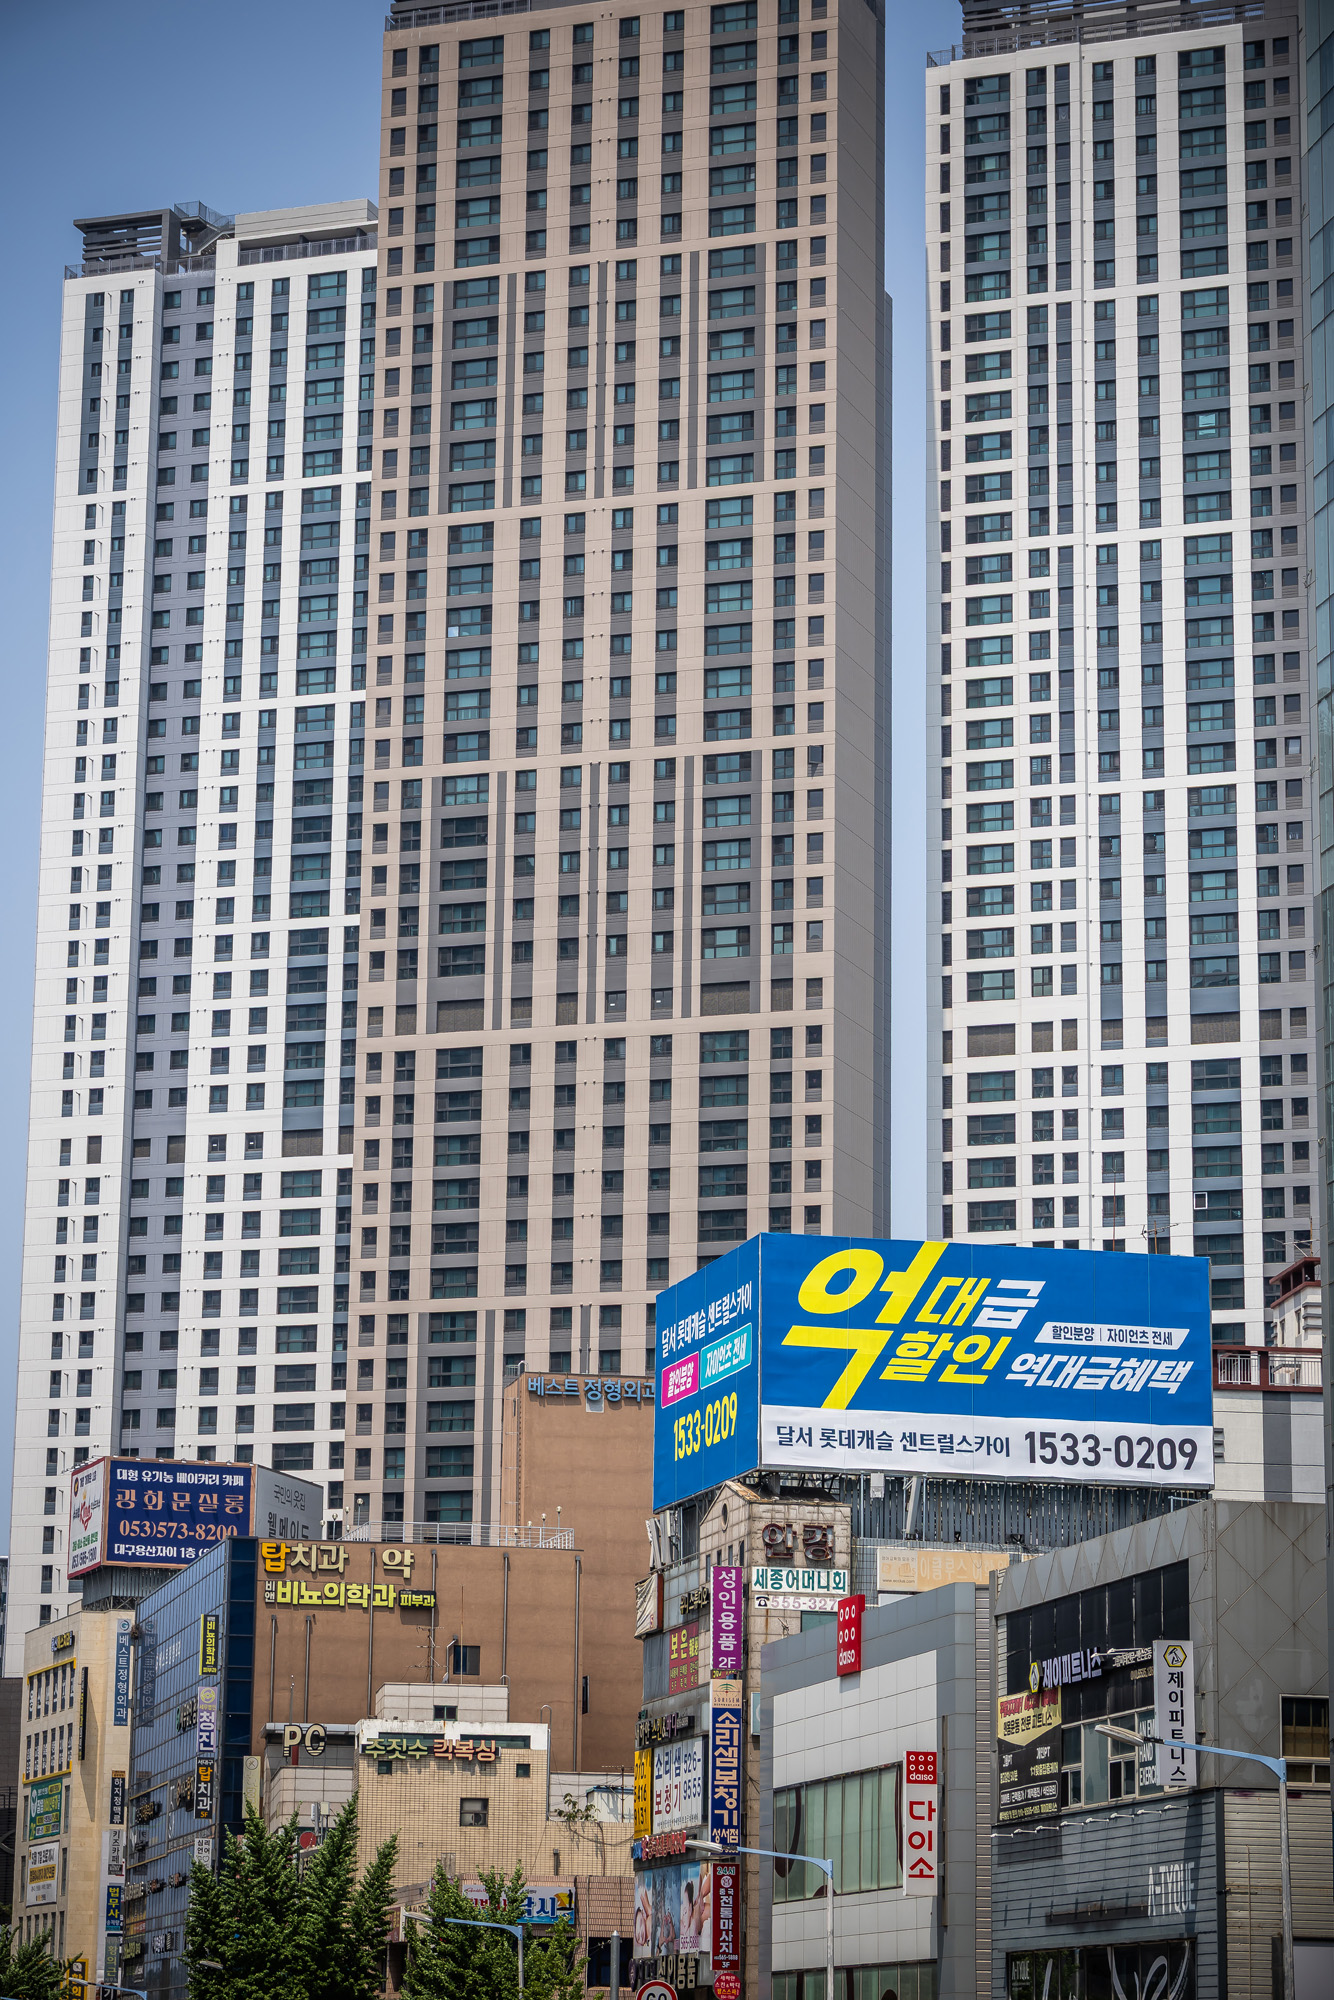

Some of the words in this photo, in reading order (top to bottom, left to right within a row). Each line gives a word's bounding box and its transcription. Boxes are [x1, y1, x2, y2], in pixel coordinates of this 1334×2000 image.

[661, 1322, 676, 1359] 달서
[677, 1308, 706, 1350] 롯데캐슬
[707, 1281, 752, 1334] 센트럴스카이
[1051, 1324, 1095, 1342] 할인분양
[1106, 1327, 1150, 1344] 자이언츠
[1151, 1329, 1174, 1346] 전세
[667, 1361, 695, 1398] 할인분양
[705, 1342, 732, 1379] 자이언츠
[732, 1333, 748, 1366] 전세
[1005, 1353, 1194, 1395] 역대급혜택
[673, 1391, 738, 1462] 1533-0209
[776, 1425, 814, 1448] 달서
[818, 1427, 895, 1452] 롯데캐슬
[899, 1431, 1010, 1458] 센트럴스카이
[1024, 1430, 1198, 1471] 1533-0209
[116, 1468, 139, 1482] 대형
[141, 1469, 174, 1483] 유기농
[176, 1472, 220, 1486] 베이커리
[222, 1474, 244, 1487] 카페
[119, 1519, 238, 1541] 053)573-8200
[762, 1522, 835, 1561] 안경
[114, 1543, 177, 1558] 대구용산자이
[179, 1546, 196, 1559] 1층
[261, 1542, 349, 1573] 탑치과
[382, 1549, 414, 1579] 약
[277, 1581, 397, 1608] 비뇨의학과
[400, 1594, 436, 1608] 피부과
[753, 1568, 847, 1593] 세종어머니회
[718, 1569, 738, 1651] 성인용품
[771, 1596, 837, 1611] 555-327
[718, 1657, 737, 1669] 2F
[839, 1648, 856, 1666] daiso
[1042, 1647, 1102, 1688] 제이피트니스
[116, 1635, 130, 1720] 베스트정형외과
[198, 1711, 215, 1753] 청진
[283, 1723, 327, 1757] PC
[1168, 1671, 1187, 1782] 제이피트니스
[365, 1737, 428, 1760] 주짓수
[433, 1738, 496, 1762] 킥복싱
[197, 1766, 213, 1812] 탑치과
[909, 1771, 934, 1781] daiso
[113, 1778, 123, 1824] 하지정맥류
[654, 1781, 681, 1816] 보청기
[683, 1776, 702, 1801] 9555
[111, 1830, 121, 1864] 키즈카페
[712, 1828, 739, 1844] 성서점
[908, 1800, 936, 1879] 다이소
[107, 1886, 120, 1919] 법무사
[1147, 1861, 1196, 1919] A-TYQUE
[719, 1895, 734, 1954] 전통마사지
